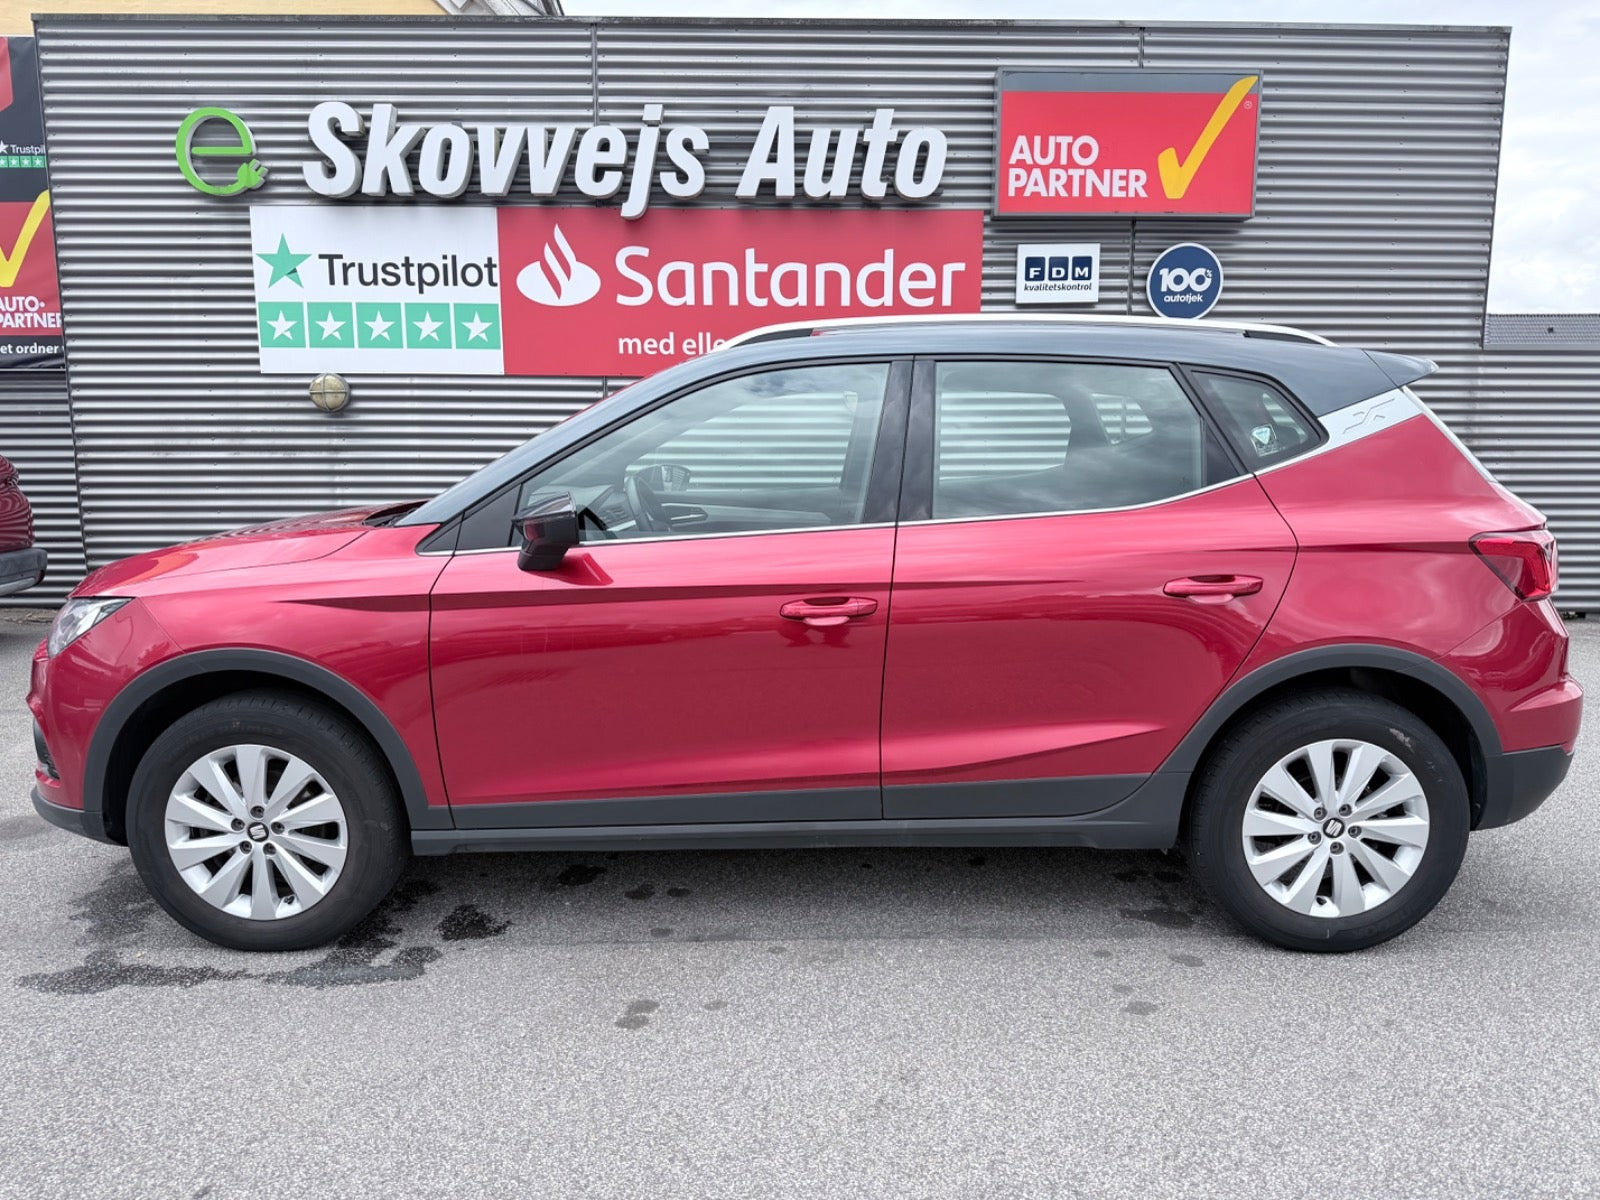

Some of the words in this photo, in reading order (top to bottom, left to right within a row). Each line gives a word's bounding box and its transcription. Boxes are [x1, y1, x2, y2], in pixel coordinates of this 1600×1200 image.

[302, 101, 710, 221] Skovvejs
[735, 105, 949, 200] Auto
[1008, 134, 1100, 166] AUTO
[1007, 167, 1149, 198] PARTNER
[318, 253, 499, 294] Trustpilot
[614, 245, 967, 308] Santander
[1023, 282, 1092, 292] kvalitetskontrol
[1163, 292, 1204, 304] autotjek
[15, 341, 59, 354] ordner
[618, 331, 675, 355] med
